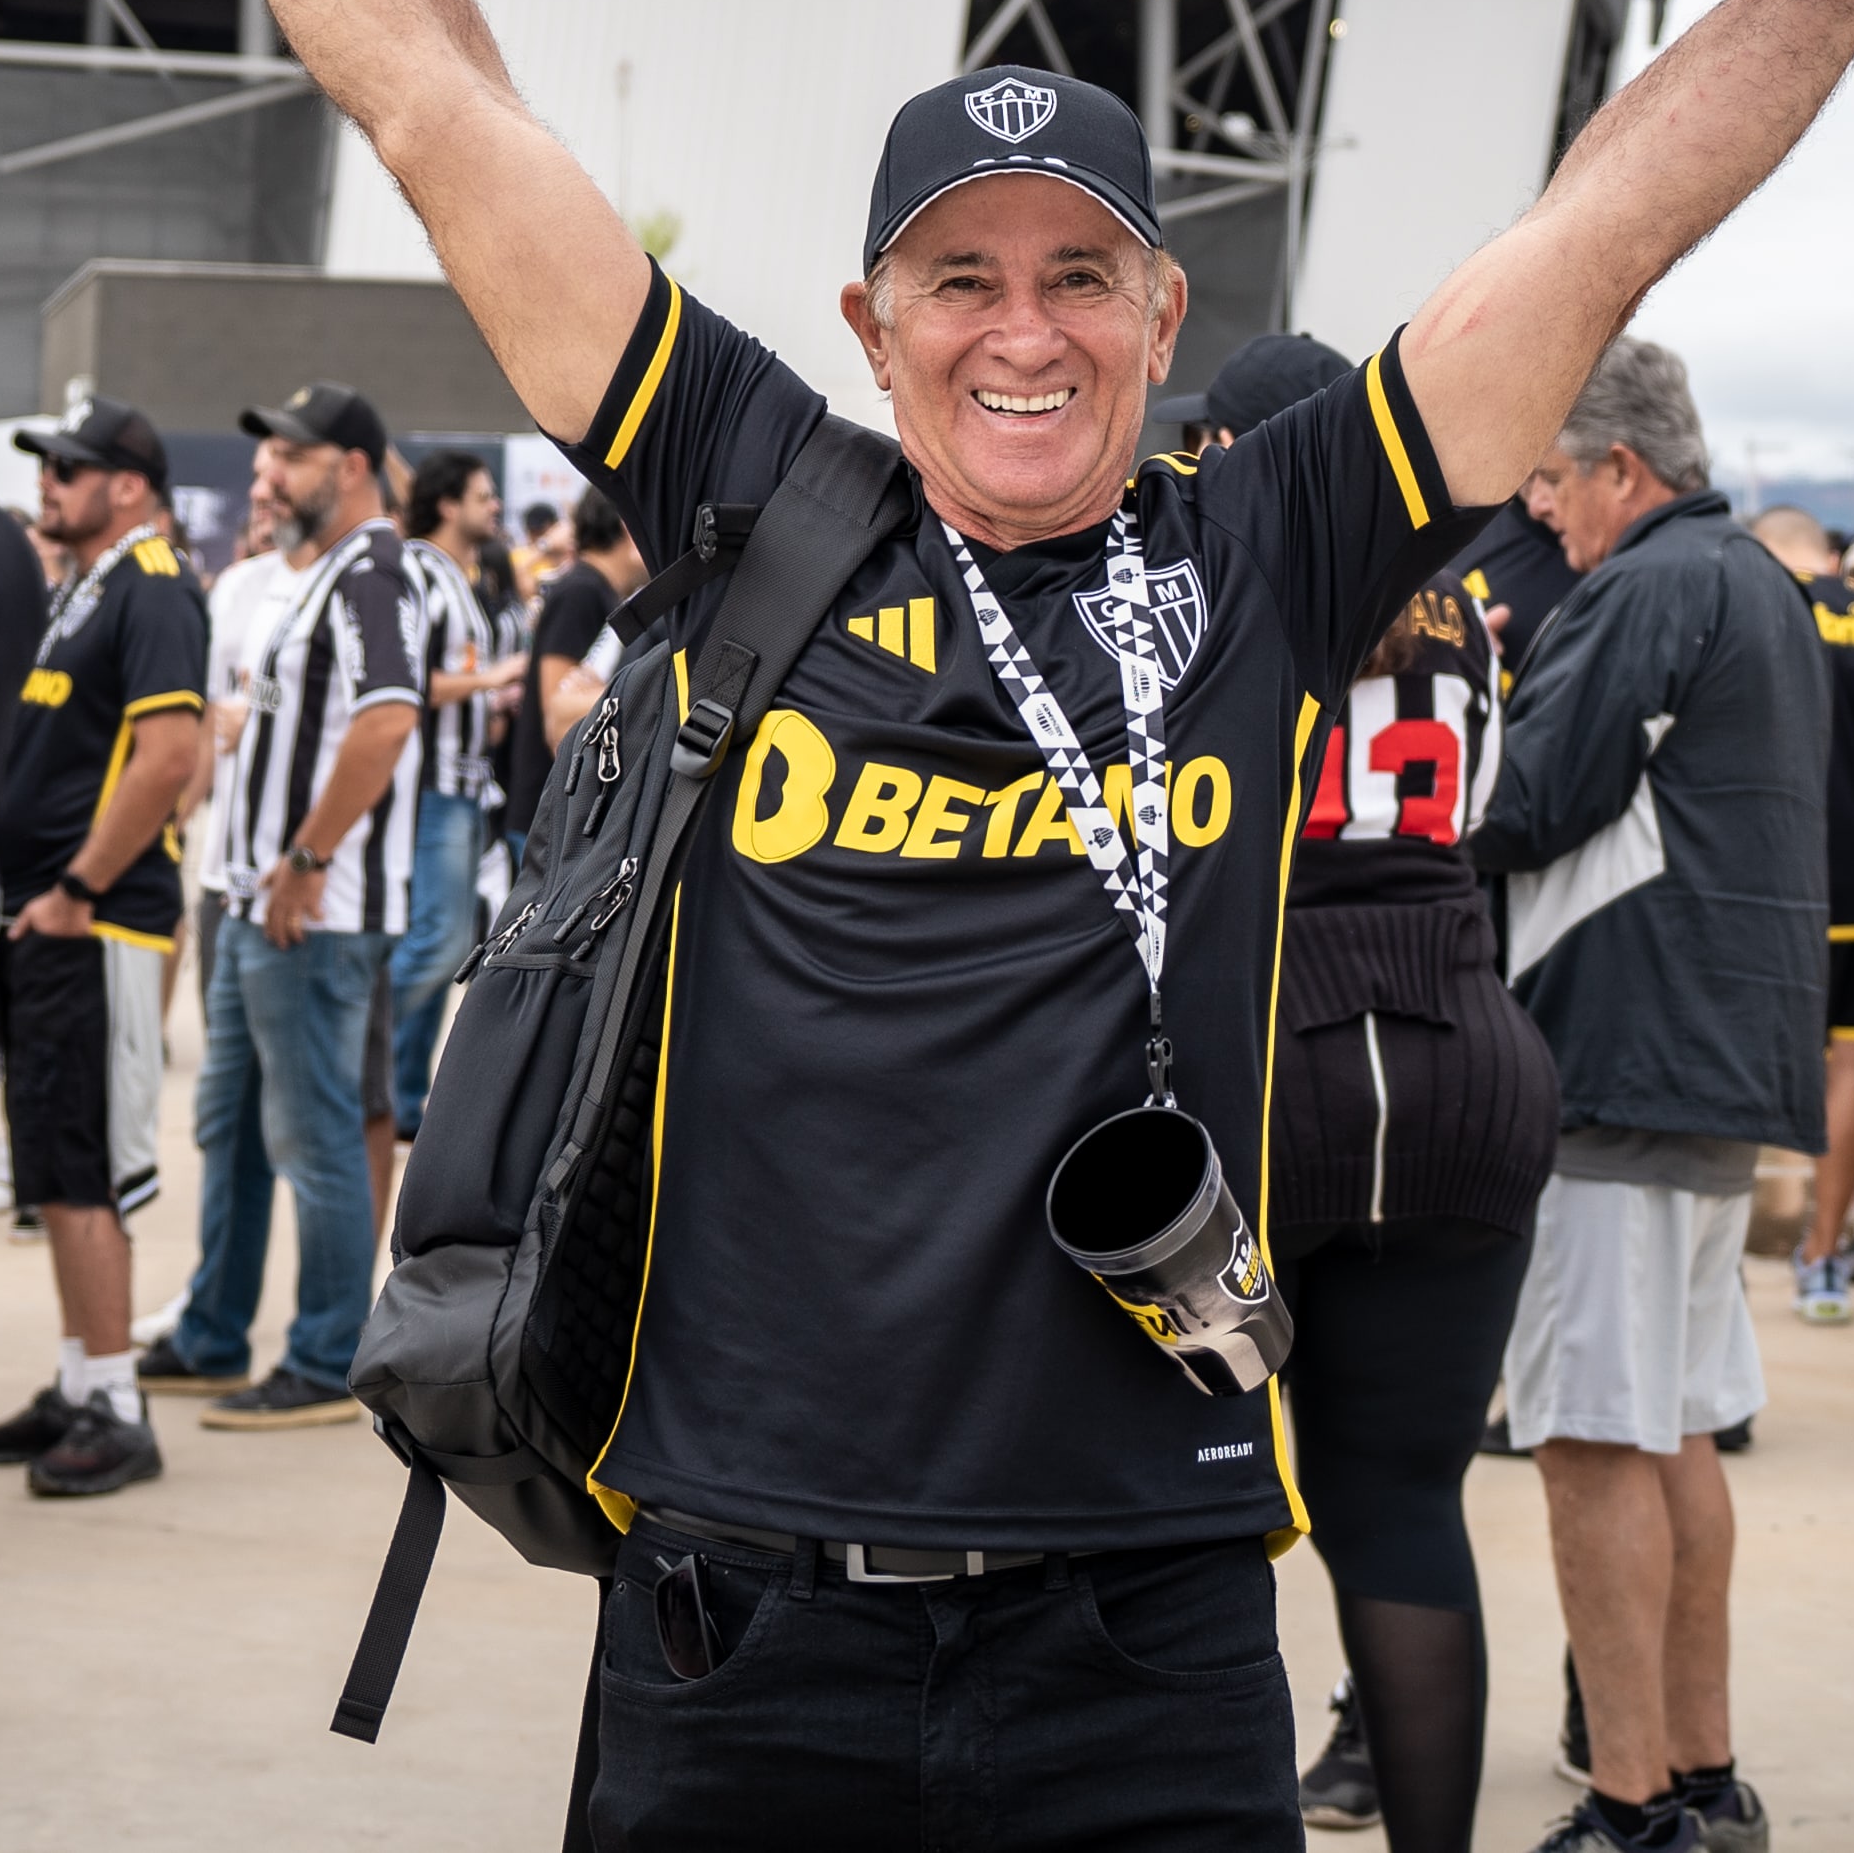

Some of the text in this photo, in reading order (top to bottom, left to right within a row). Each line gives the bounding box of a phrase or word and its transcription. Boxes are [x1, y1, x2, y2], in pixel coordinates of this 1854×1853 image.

[979, 88, 1042, 103] CAM
[1100, 579, 1183, 619] CM
[1408, 589, 1466, 648] ALO
[1197, 1441, 1253, 1463] AEROREADY
